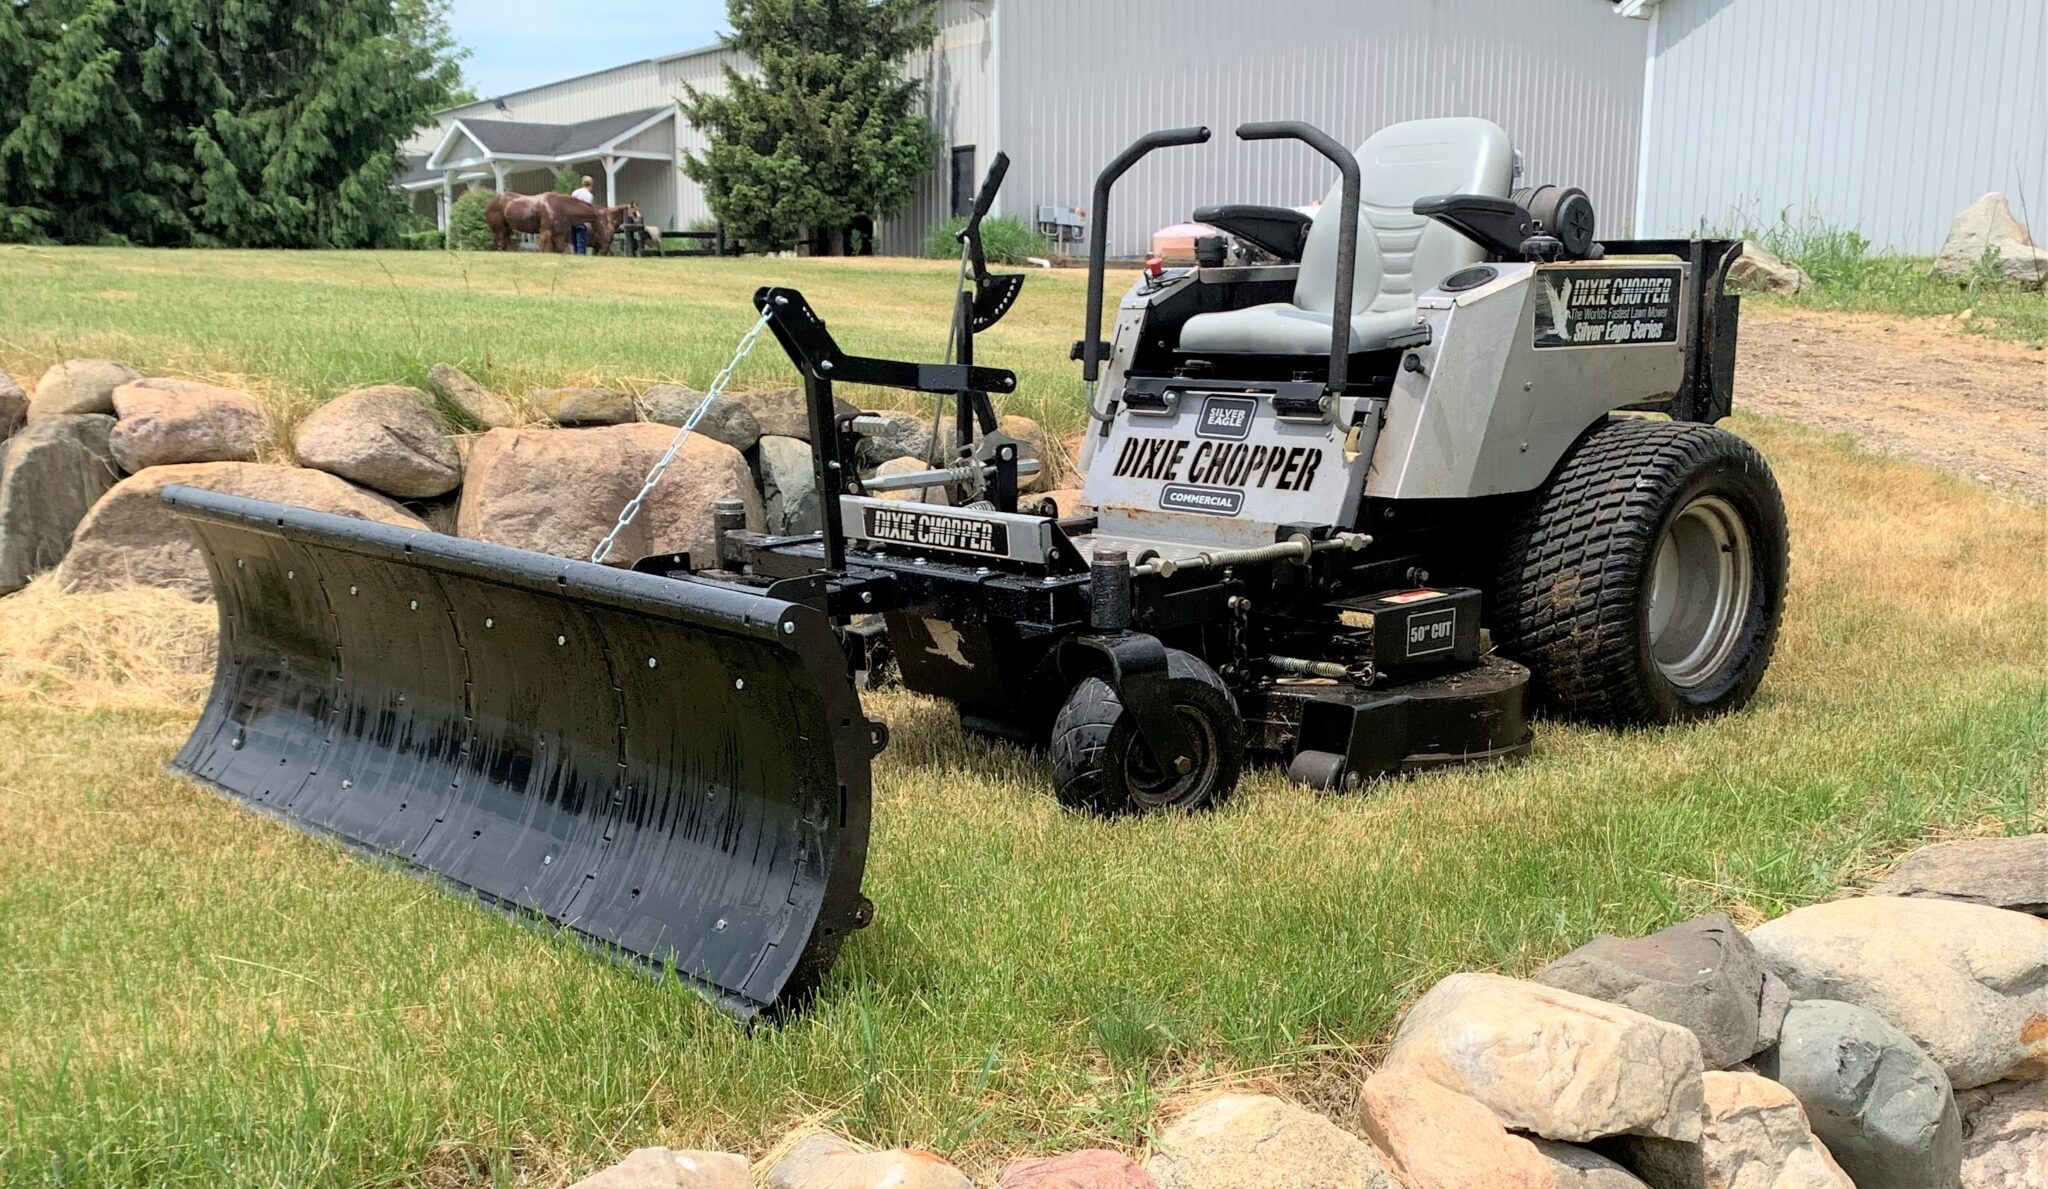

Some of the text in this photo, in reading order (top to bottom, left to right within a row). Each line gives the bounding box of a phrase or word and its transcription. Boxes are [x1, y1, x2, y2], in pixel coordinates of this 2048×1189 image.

[1571, 277, 1672, 306] DIXIE CHOPPER
[1571, 306, 1668, 320] The World's Fastest Lawn Mower
[1573, 319, 1664, 342] Silver Eagle Series
[1207, 416, 1245, 427] EAGLE
[1209, 407, 1246, 420] SILVER
[1112, 437, 1323, 492] DIXIE CHOPPER
[1170, 492, 1233, 508] COMMERCIAL
[873, 510, 993, 551] DIXIE CHOPPER
[1410, 621, 1452, 643] 50" CUT
